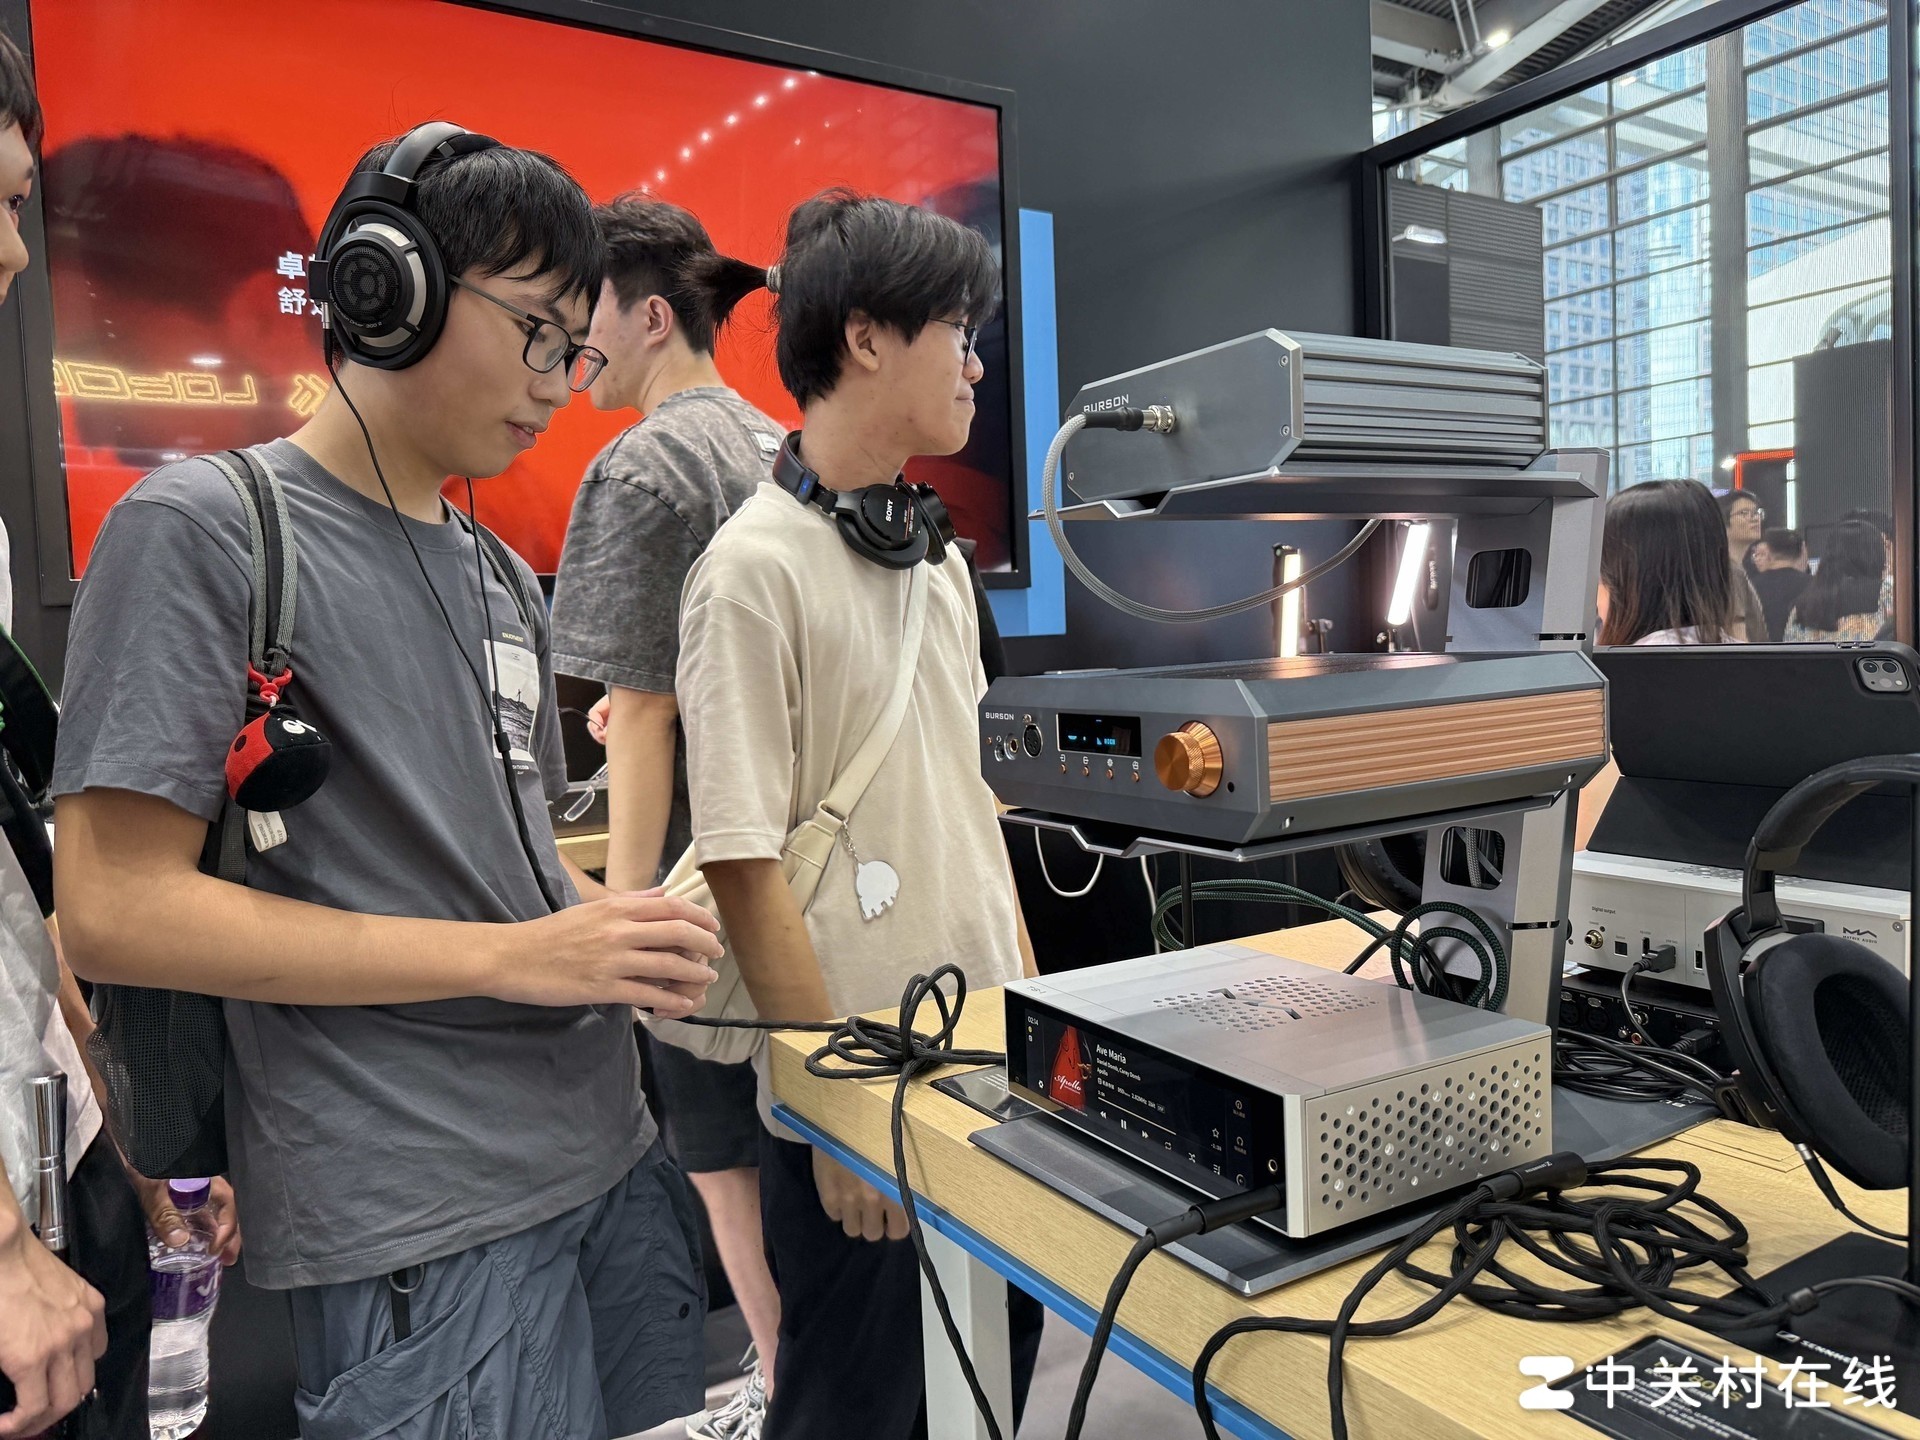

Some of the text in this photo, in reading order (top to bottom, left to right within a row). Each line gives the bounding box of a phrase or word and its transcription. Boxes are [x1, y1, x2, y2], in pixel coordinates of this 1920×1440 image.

[1083, 394, 1129, 413] BURSON
[885, 499, 894, 522] SONY
[985, 711, 1015, 721] BURSON
[1096, 1044, 1127, 1064] Ave Maria
[1053, 1074, 1082, 1091] Apollo
